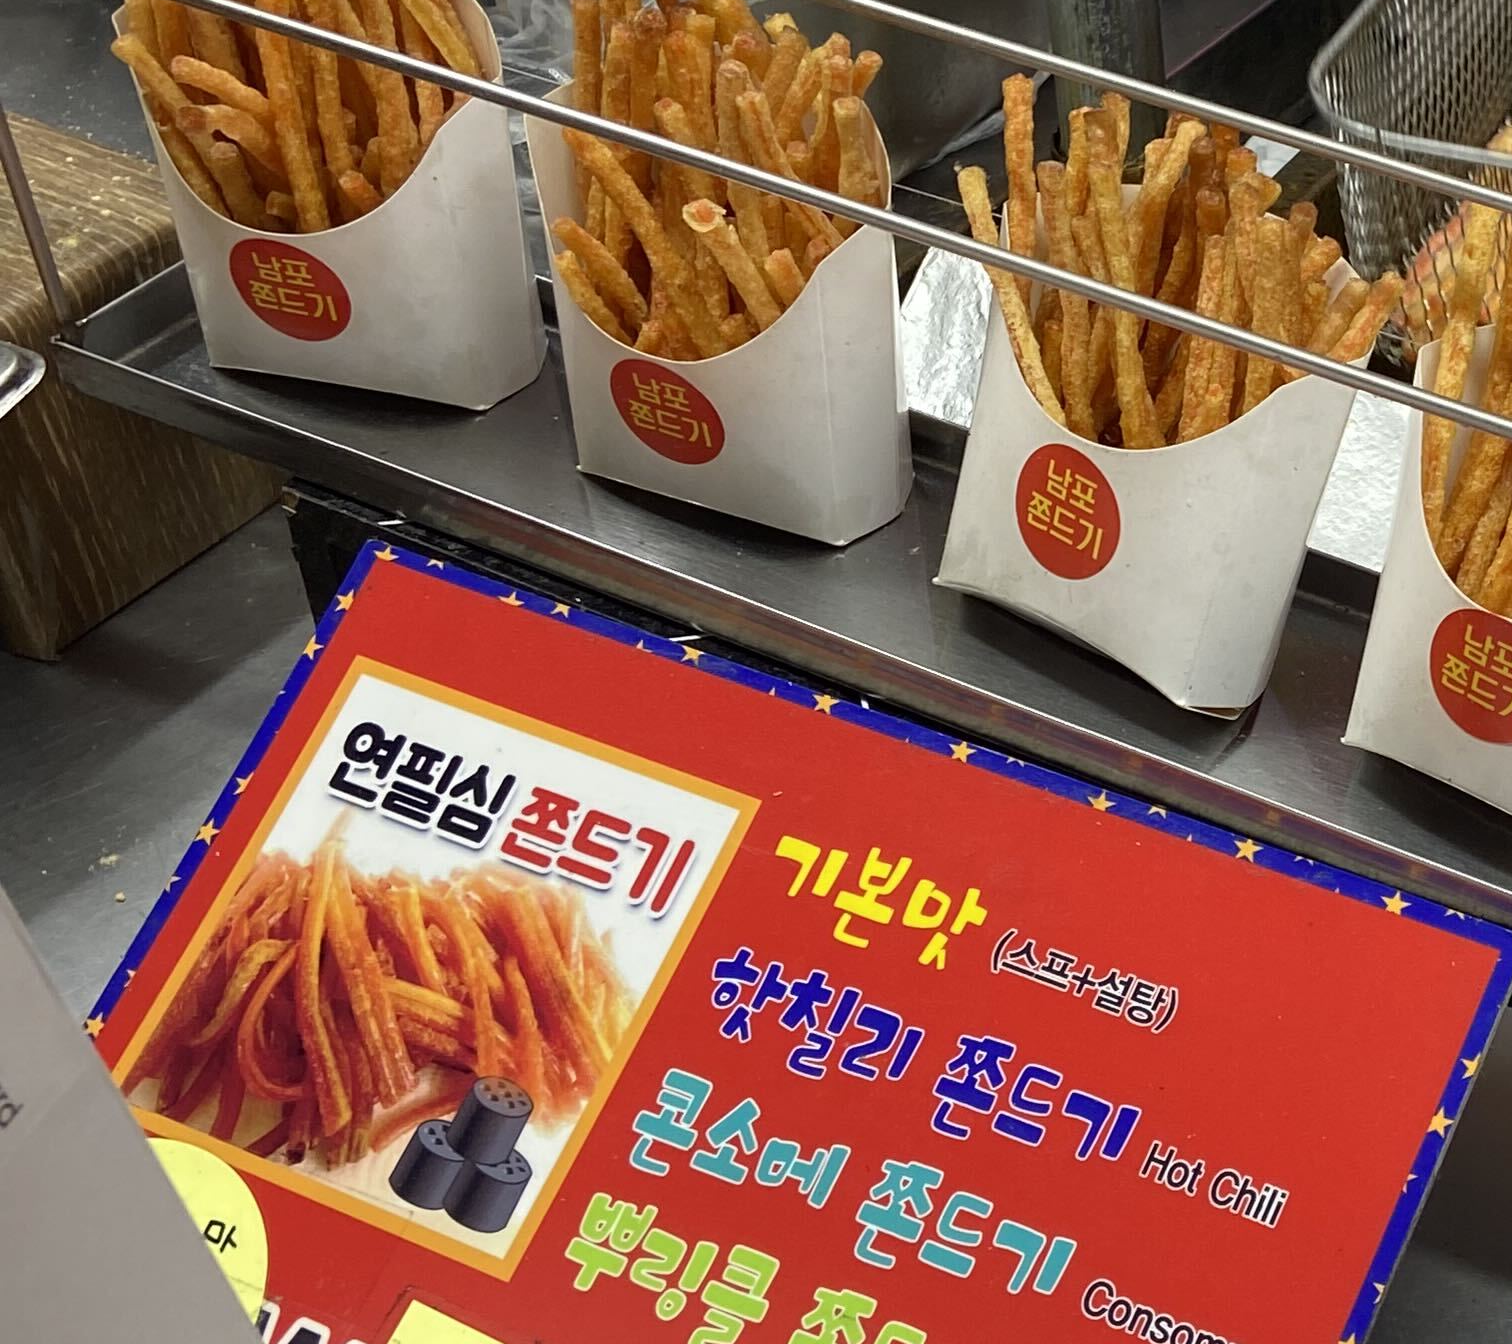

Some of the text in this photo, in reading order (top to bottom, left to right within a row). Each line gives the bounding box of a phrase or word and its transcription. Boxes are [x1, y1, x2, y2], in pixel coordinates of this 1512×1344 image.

[249, 279, 340, 322] 쫀드기
[250, 250, 314, 288] 남포
[628, 399, 713, 450] 쫀드기
[631, 372, 690, 414] 남포
[1045, 458, 1098, 516] 남포
[1026, 490, 1105, 561] 쫀드기
[327, 721, 697, 914] 연필심 쫀드기
[772, 836, 1183, 1033] 기본맛 (스프+설탕)
[711, 948, 1290, 1229] 핫칠리 쫀드기 Hot Chili
[630, 1068, 851, 1210] 콘소메
[854, 1158, 1078, 1297] 쫀드기
